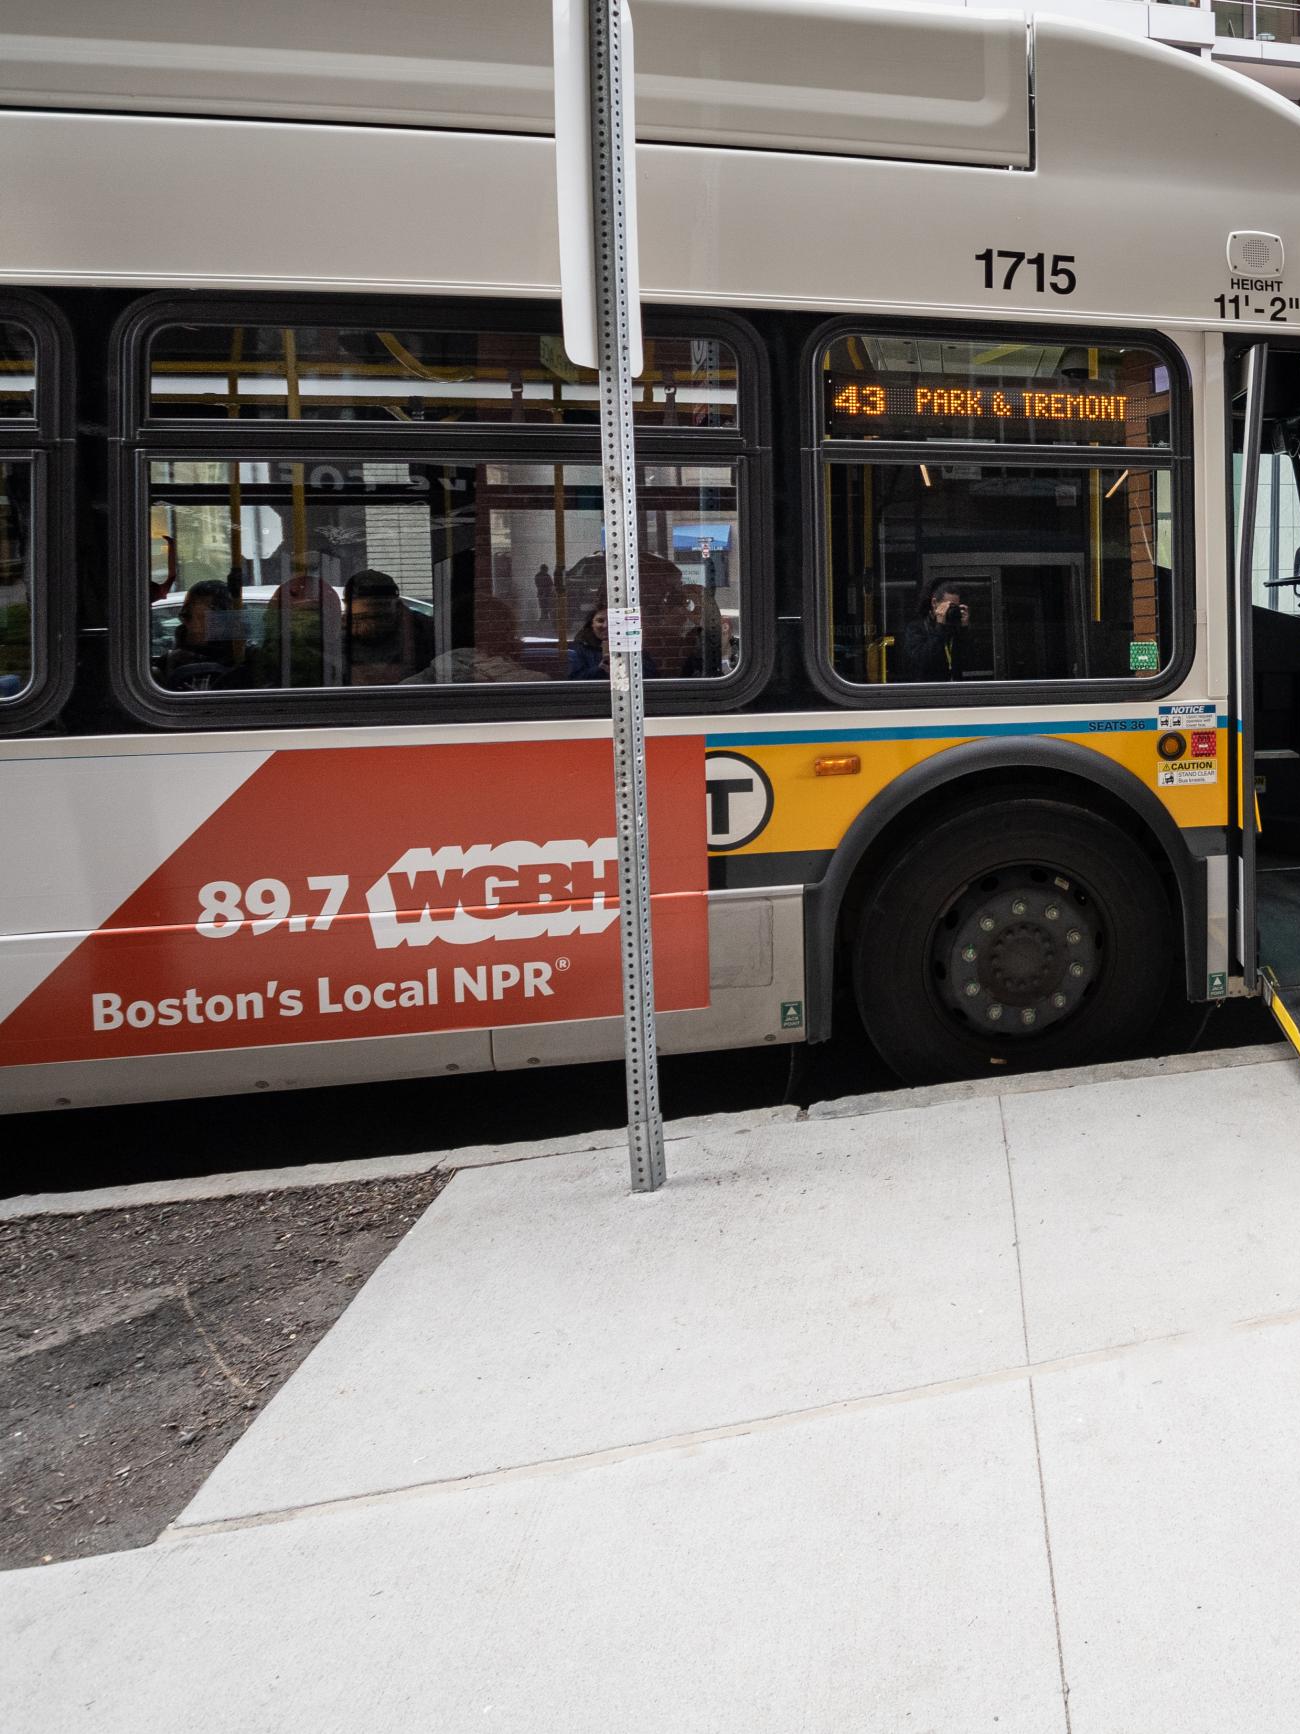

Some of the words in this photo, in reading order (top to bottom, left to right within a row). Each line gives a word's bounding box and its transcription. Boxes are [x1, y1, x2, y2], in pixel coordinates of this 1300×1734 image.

[974, 248, 1077, 295] 1715
[1230, 278, 1283, 293] HEIGHT
[833, 385, 886, 416] 43
[916, 388, 983, 416] PARK
[992, 391, 1012, 416] &
[1022, 392, 1128, 421] TREMONT
[1088, 721, 1127, 732] SEATS
[1130, 720, 1145, 730] 36
[1170, 705, 1205, 714] NOTICE
[1171, 761, 1213, 771] CAUTION
[706, 778, 754, 836] T
[195, 875, 349, 939] 89.7
[374, 845, 620, 938] WGBH
[92, 980, 304, 1032] Boston's
[318, 967, 438, 1014] Local
